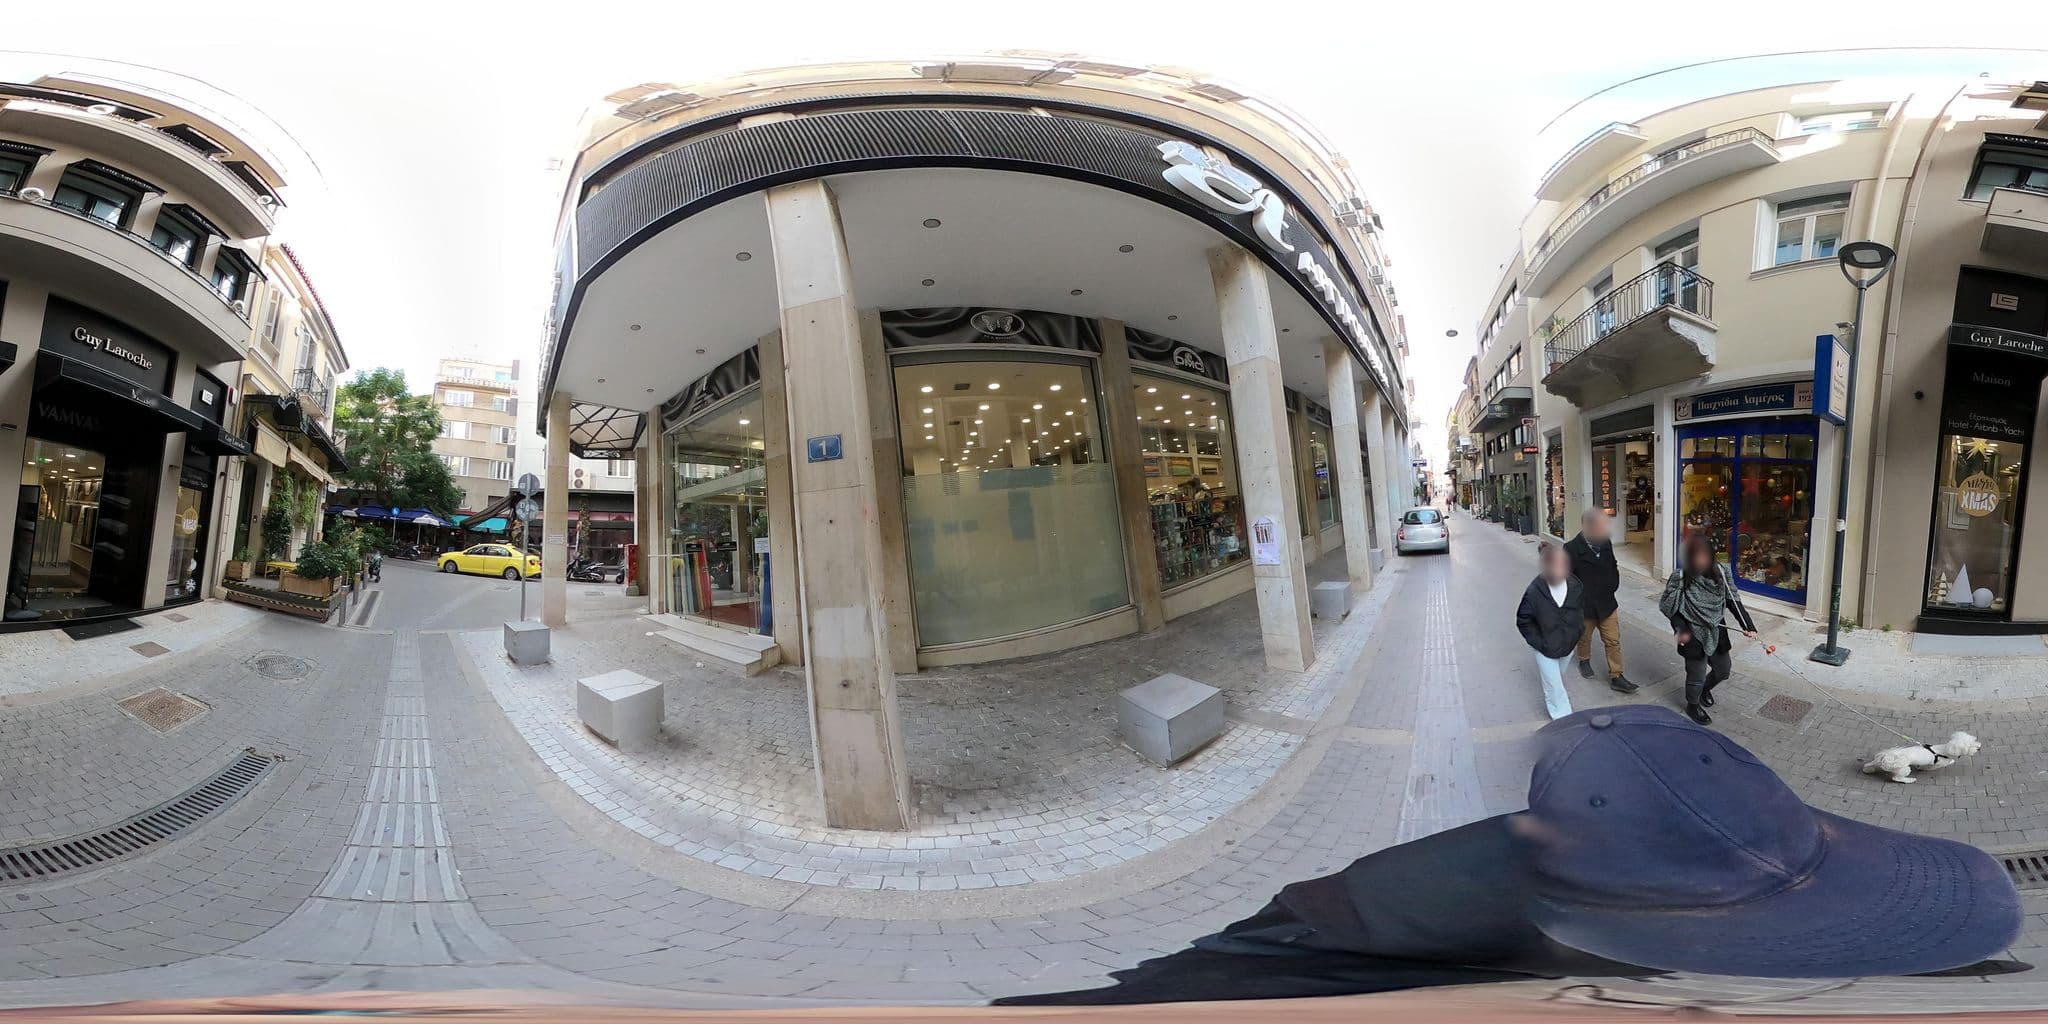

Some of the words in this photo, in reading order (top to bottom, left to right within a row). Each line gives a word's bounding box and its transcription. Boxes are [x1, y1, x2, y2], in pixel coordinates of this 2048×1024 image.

[74, 326, 102, 350] Guy
[104, 338, 153, 370] Laroche
[1970, 331, 1994, 348] Guy
[1998, 335, 2044, 352] Laroche
[1174, 355, 1205, 373] DMC
[1972, 371, 2012, 387] Maison
[1948, 419, 1969, 429] Hotel
[1973, 422, 1999, 433] Airbnb
[2003, 426, 2025, 436] Yacht
[818, 439, 827, 456] 1
[1960, 490, 1997, 512] XMAS
